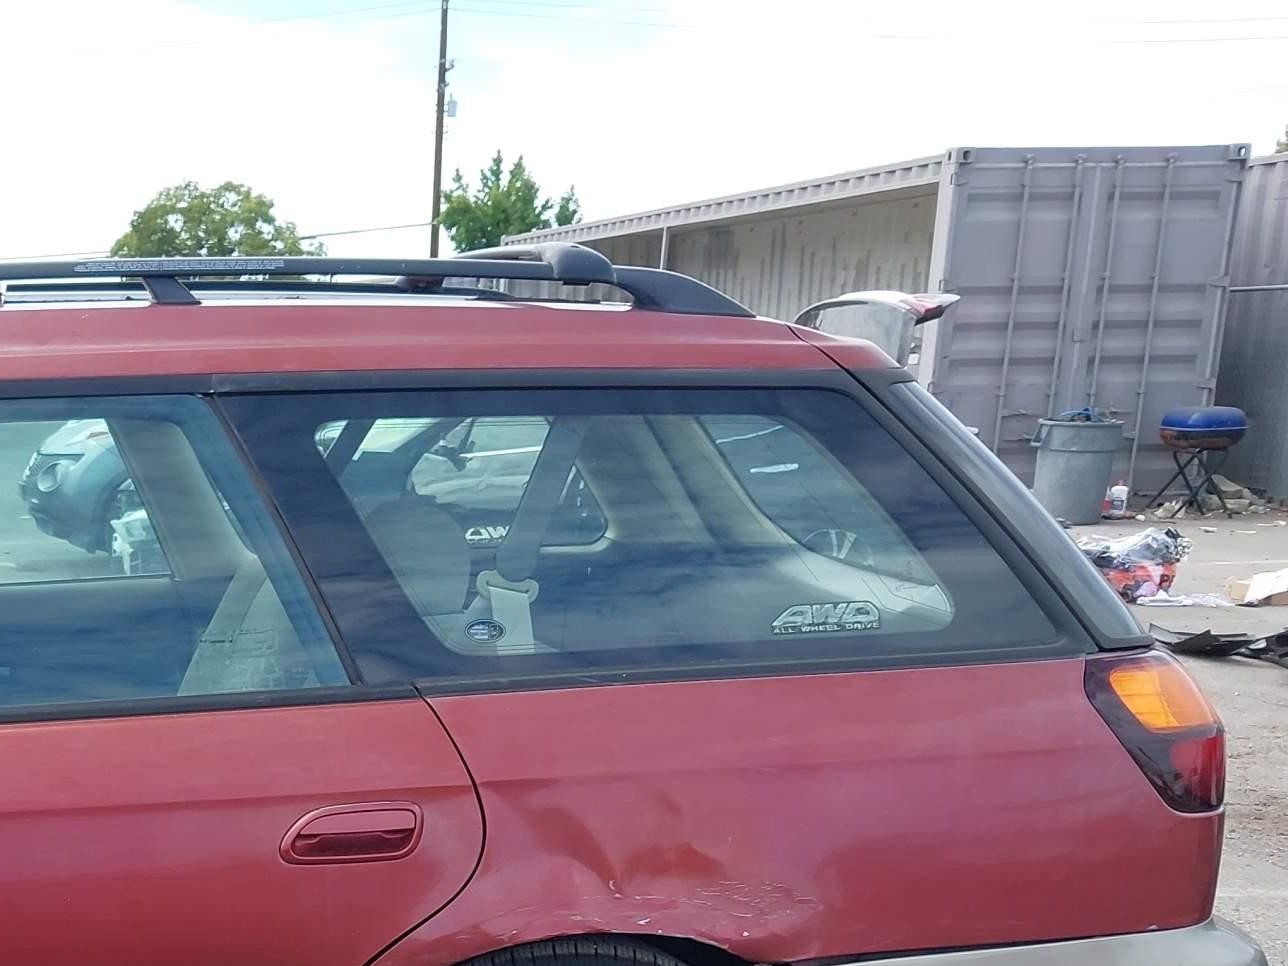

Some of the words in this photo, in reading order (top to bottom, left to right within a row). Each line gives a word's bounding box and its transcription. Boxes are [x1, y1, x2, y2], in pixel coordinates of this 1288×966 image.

[772, 601, 880, 626] AWD
[801, 624, 841, 633] WHEEL
[846, 622, 881, 631] DRIVE
